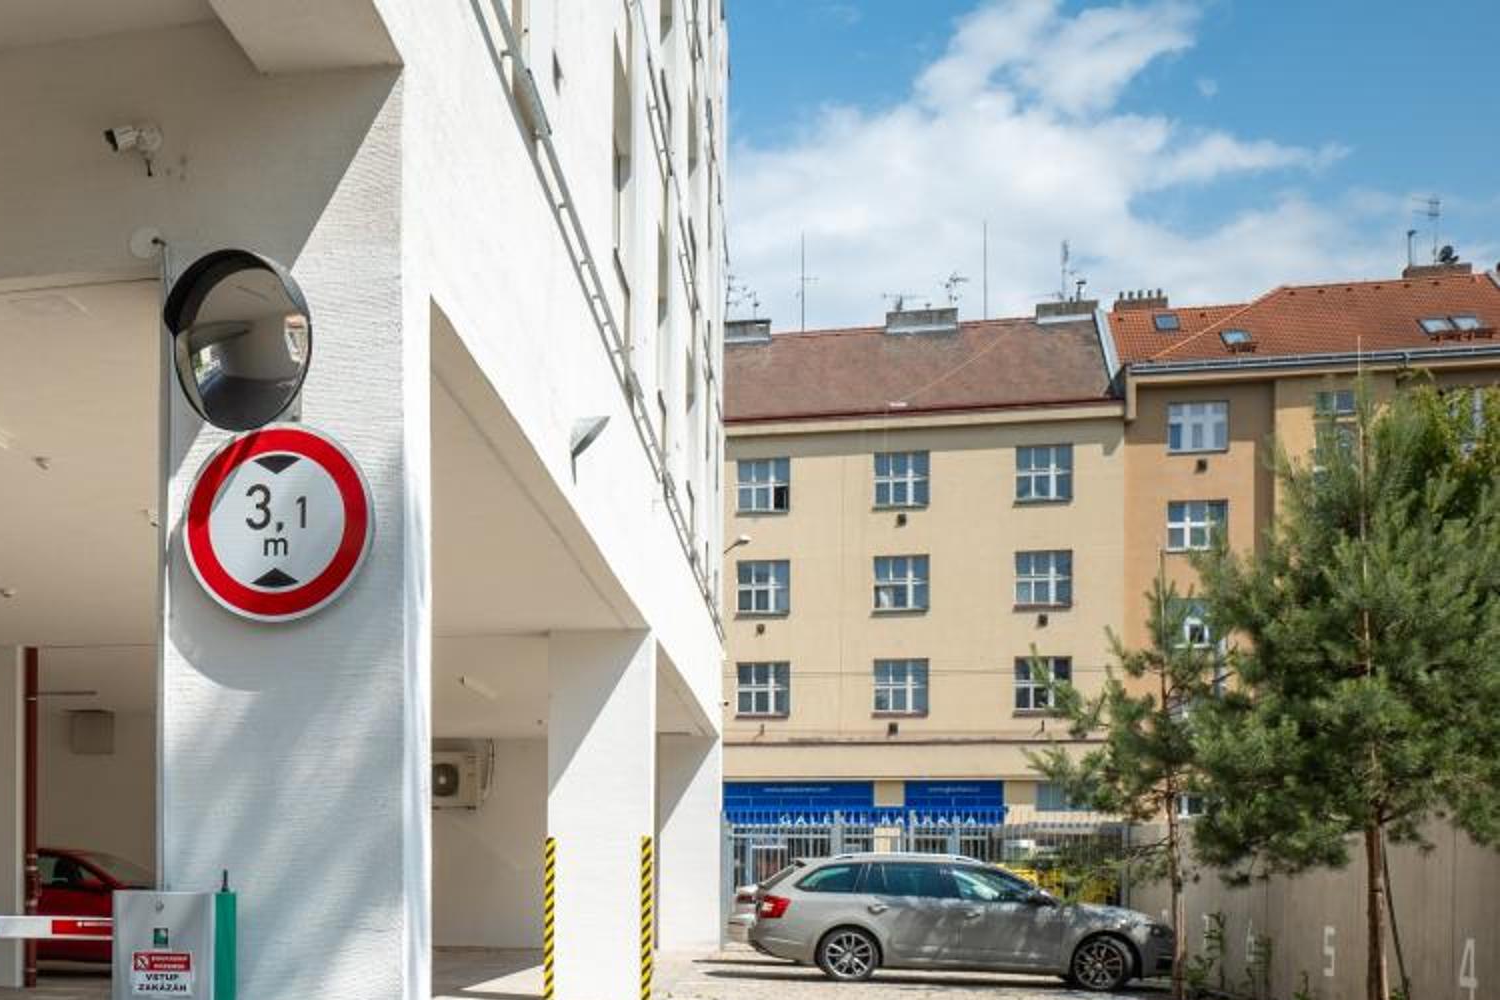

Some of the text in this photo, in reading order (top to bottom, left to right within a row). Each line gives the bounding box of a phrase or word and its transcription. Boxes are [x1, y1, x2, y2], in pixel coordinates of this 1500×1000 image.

[246, 484, 307, 533] 3,1
[263, 537, 288, 556] m
[1323, 925, 1336, 977] 5
[145, 973, 179, 981] VSTUP
